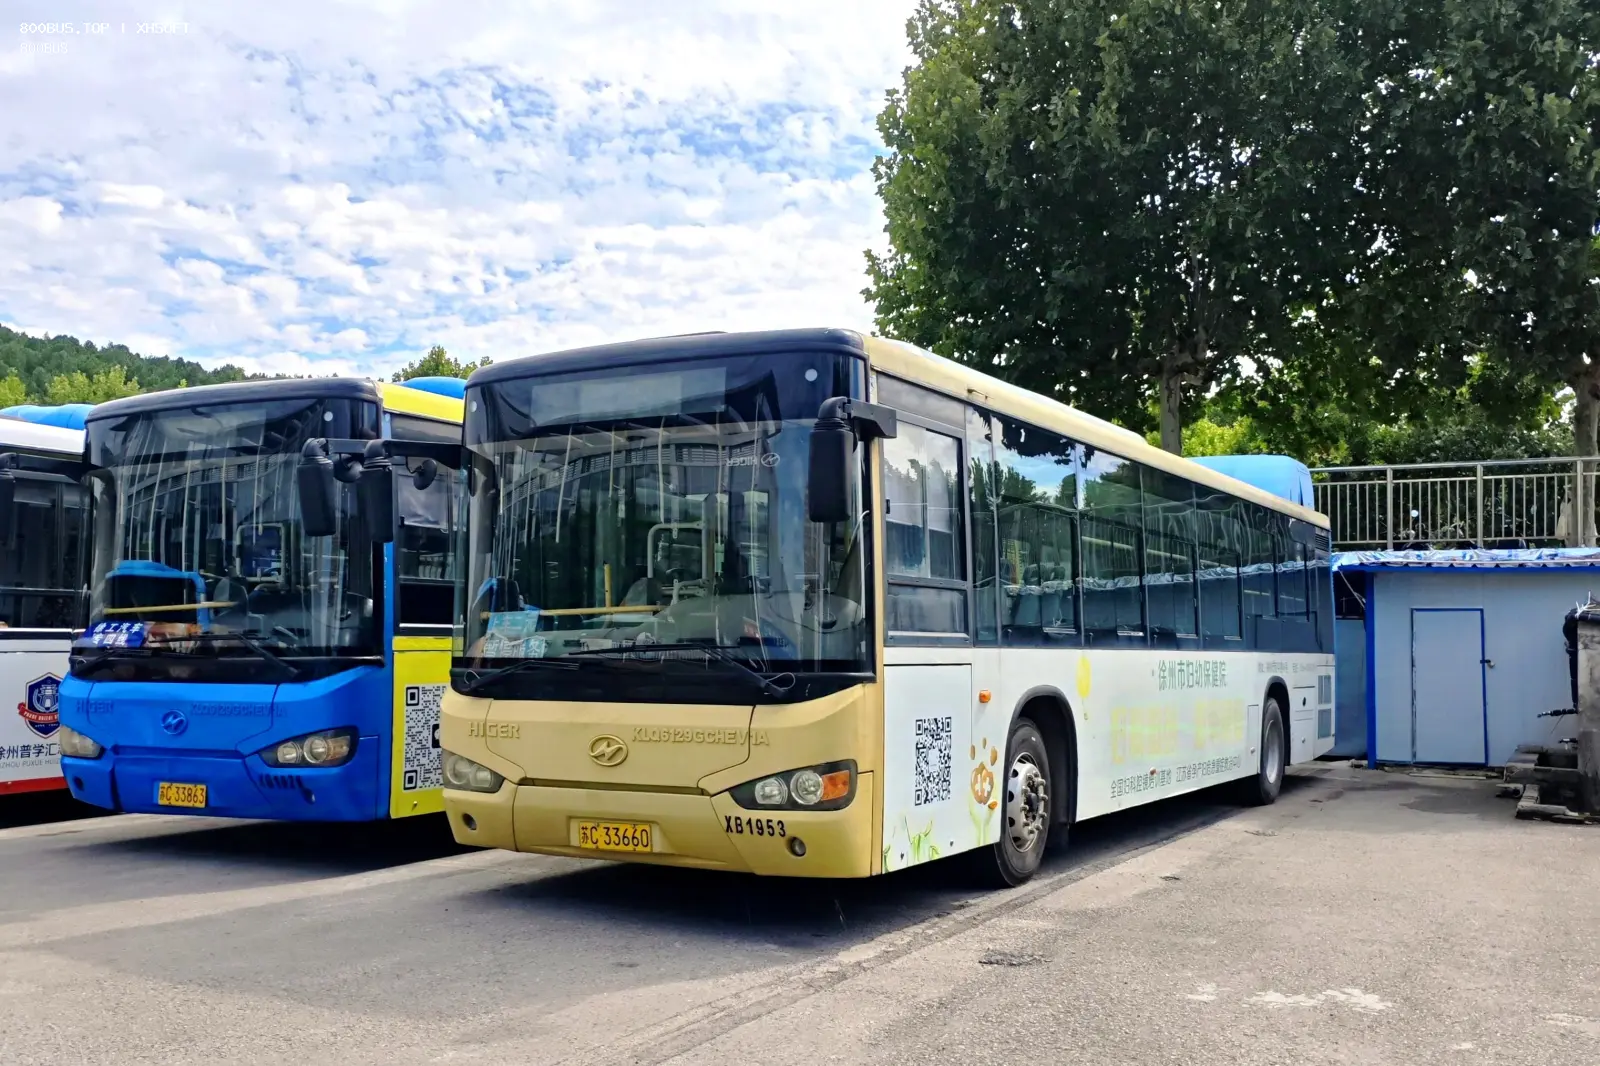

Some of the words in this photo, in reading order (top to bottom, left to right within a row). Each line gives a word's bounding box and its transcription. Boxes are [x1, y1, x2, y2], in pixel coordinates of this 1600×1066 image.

[1158, 659, 1227, 691] 徐州市妇幼保健院
[468, 722, 520, 739] HIGER
[0, 743, 61, 760] 州普学汇
[725, 814, 787, 838] XB1953
